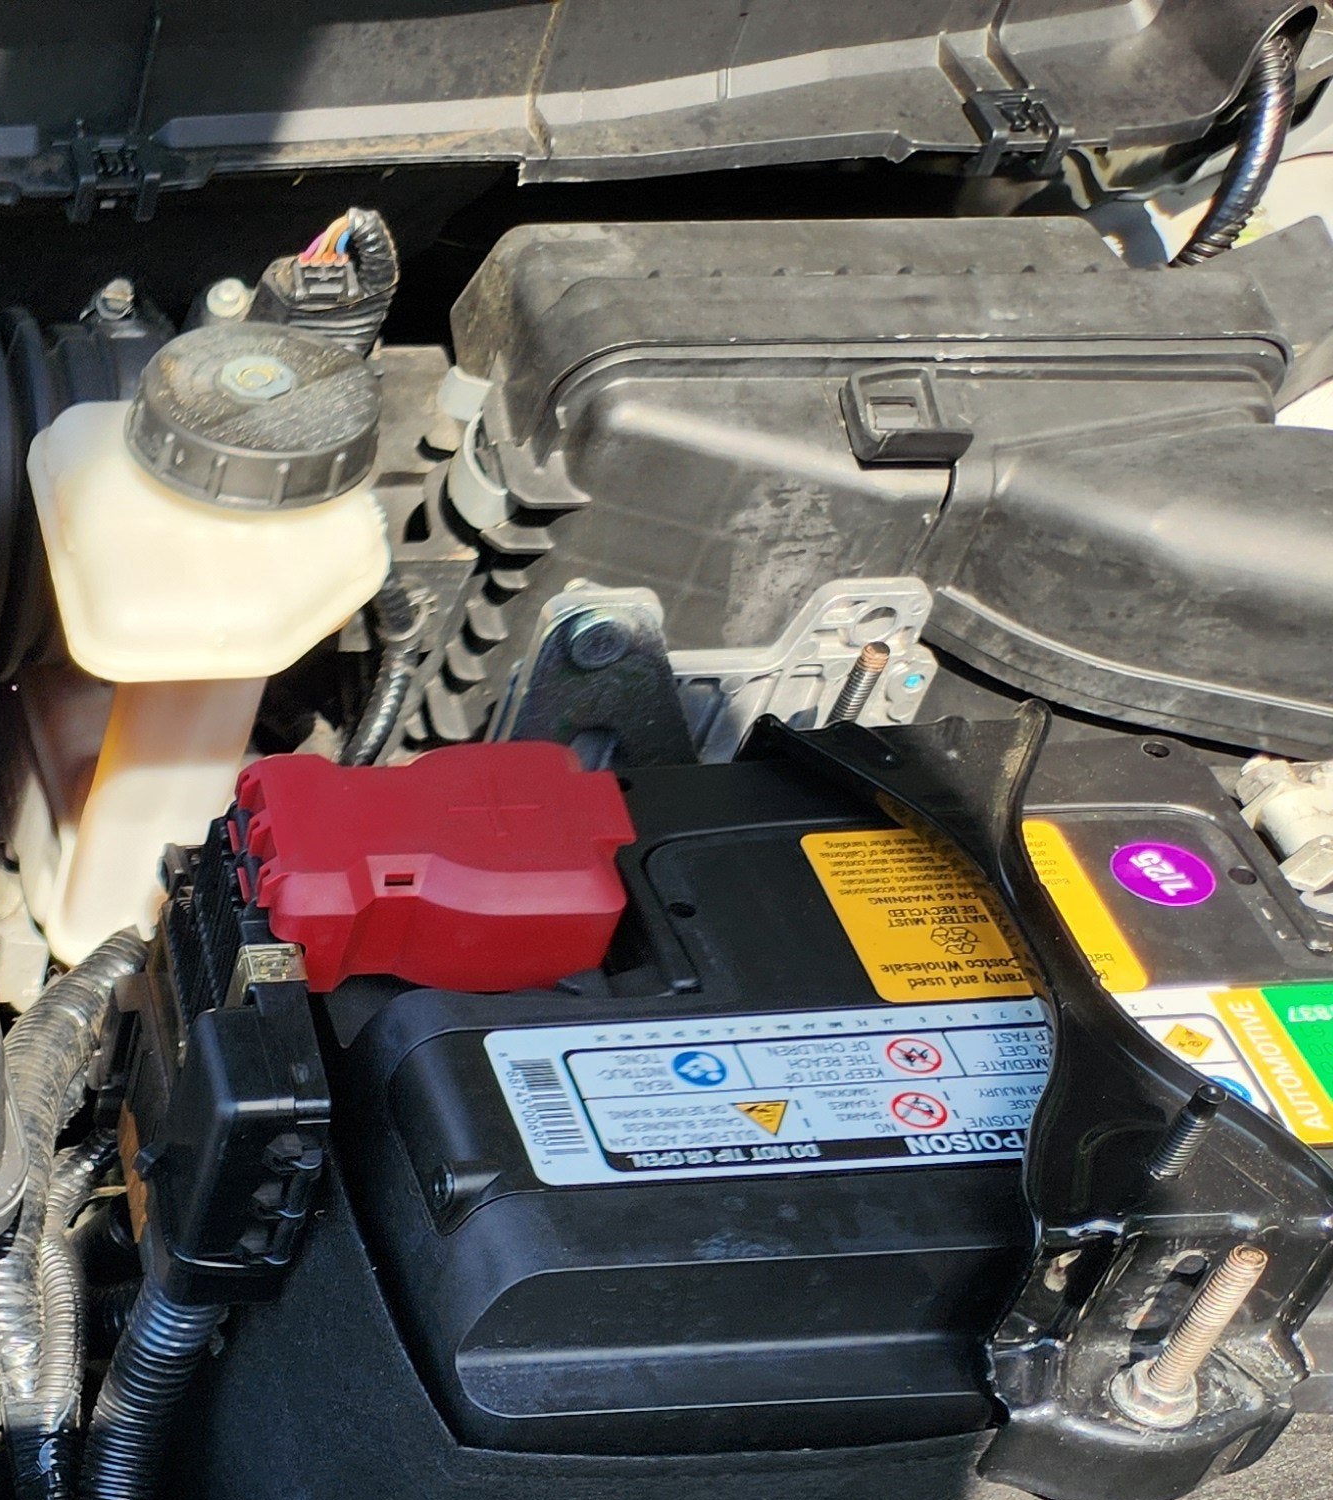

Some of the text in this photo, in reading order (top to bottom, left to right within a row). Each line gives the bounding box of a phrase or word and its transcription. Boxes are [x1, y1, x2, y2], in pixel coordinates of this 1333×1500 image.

[868, 895, 932, 905] WARNING
[888, 906, 956, 917] RECYCLED
[888, 914, 989, 928] BATTERY MUST
[880, 960, 961, 975] Wholesale
[907, 977, 945, 990] used
[950, 975, 978, 988] and
[998, 1046, 1028, 1057] GET
[850, 1055, 875, 1066] THE
[843, 1068, 884, 1080] KEEP
[904, 1131, 1018, 1154] POISON
